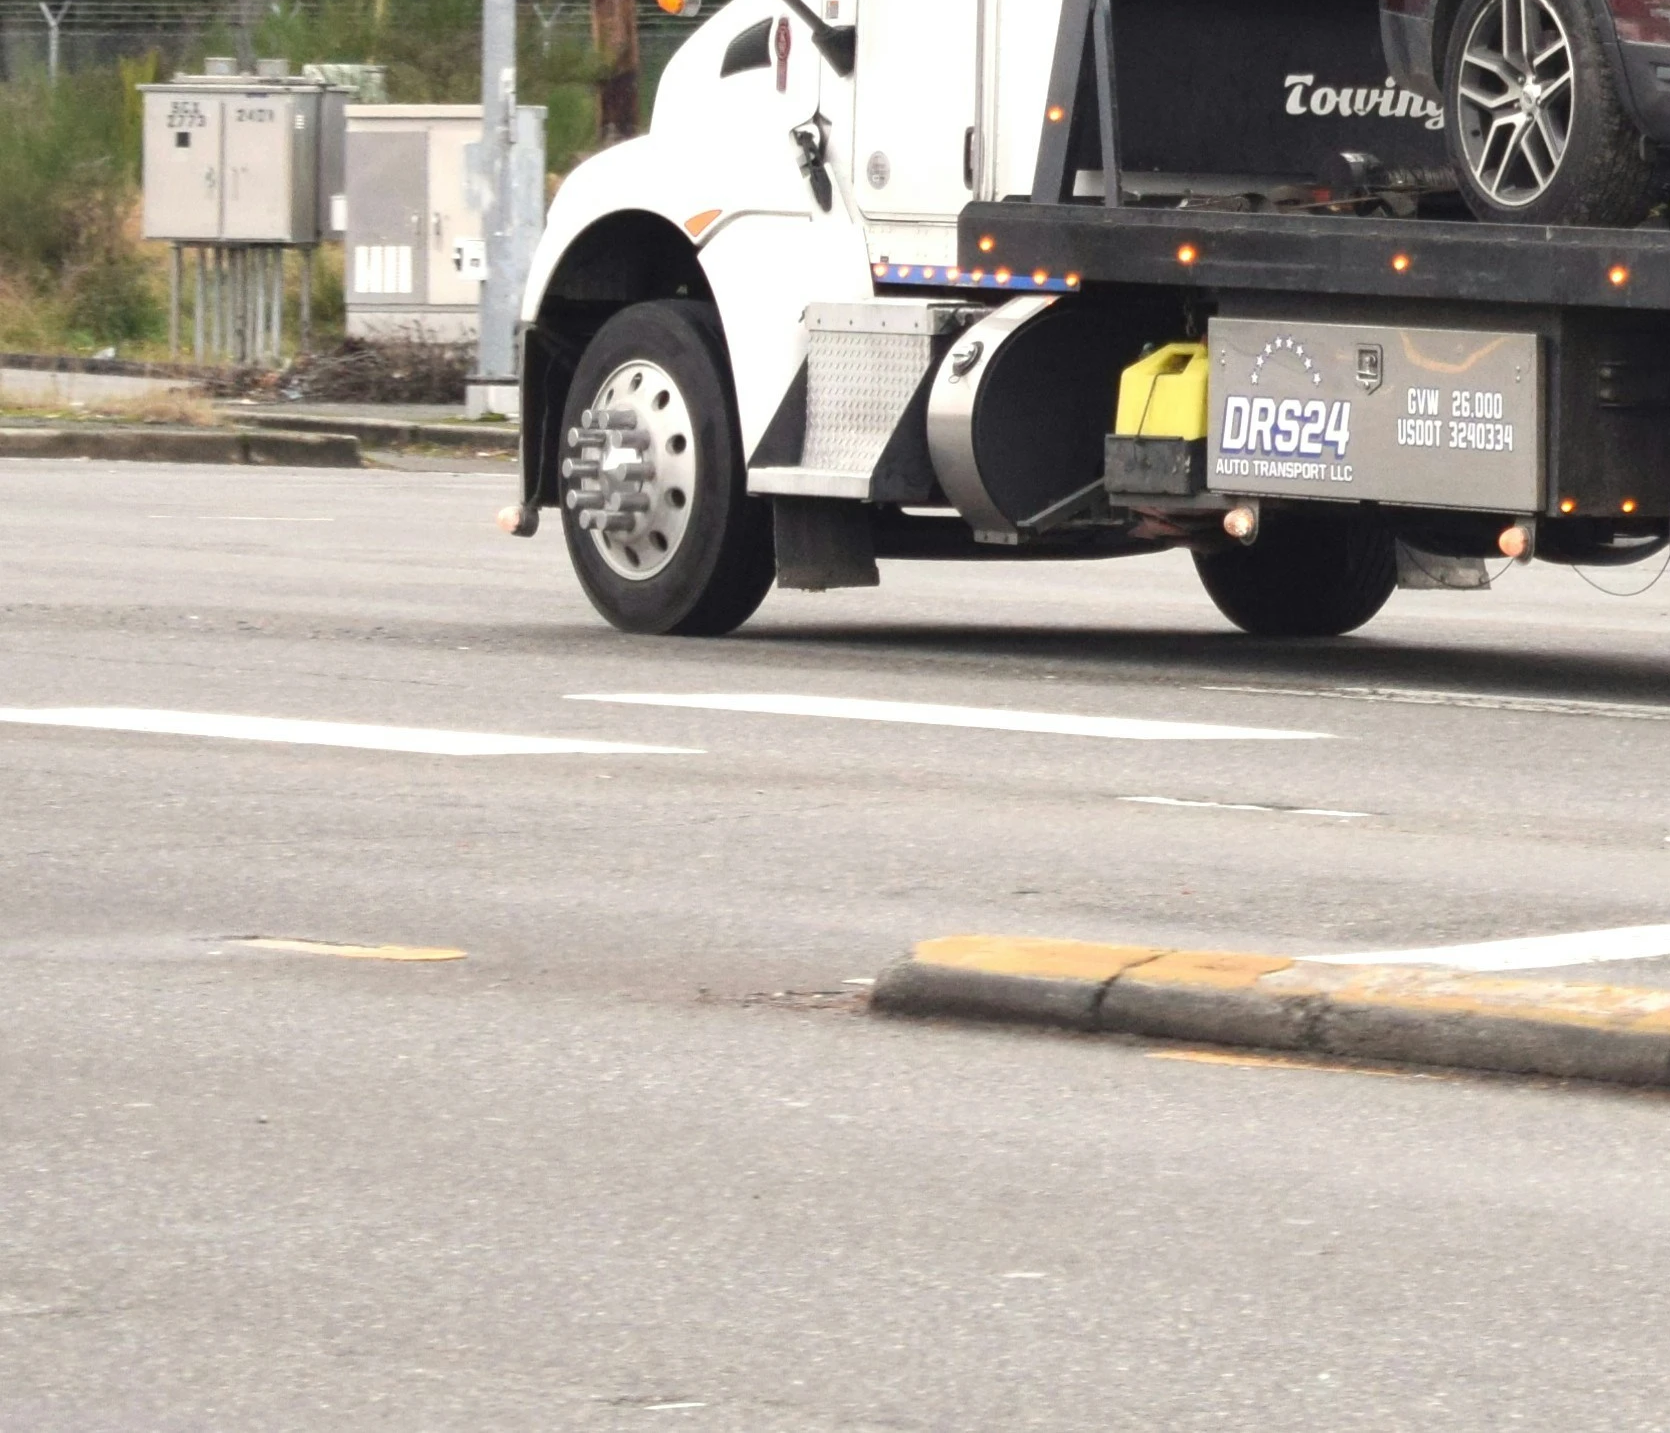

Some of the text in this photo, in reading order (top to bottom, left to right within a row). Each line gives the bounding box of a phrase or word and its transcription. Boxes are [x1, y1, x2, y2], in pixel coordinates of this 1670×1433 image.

[1284, 74, 1444, 130] Towing
[1407, 387, 1439, 416] GVW
[1220, 395, 1351, 458] DRS24
[1397, 418, 1513, 452] USDOT 3240334
[1216, 458, 1353, 482] AUTO TRANSPORT LLC
